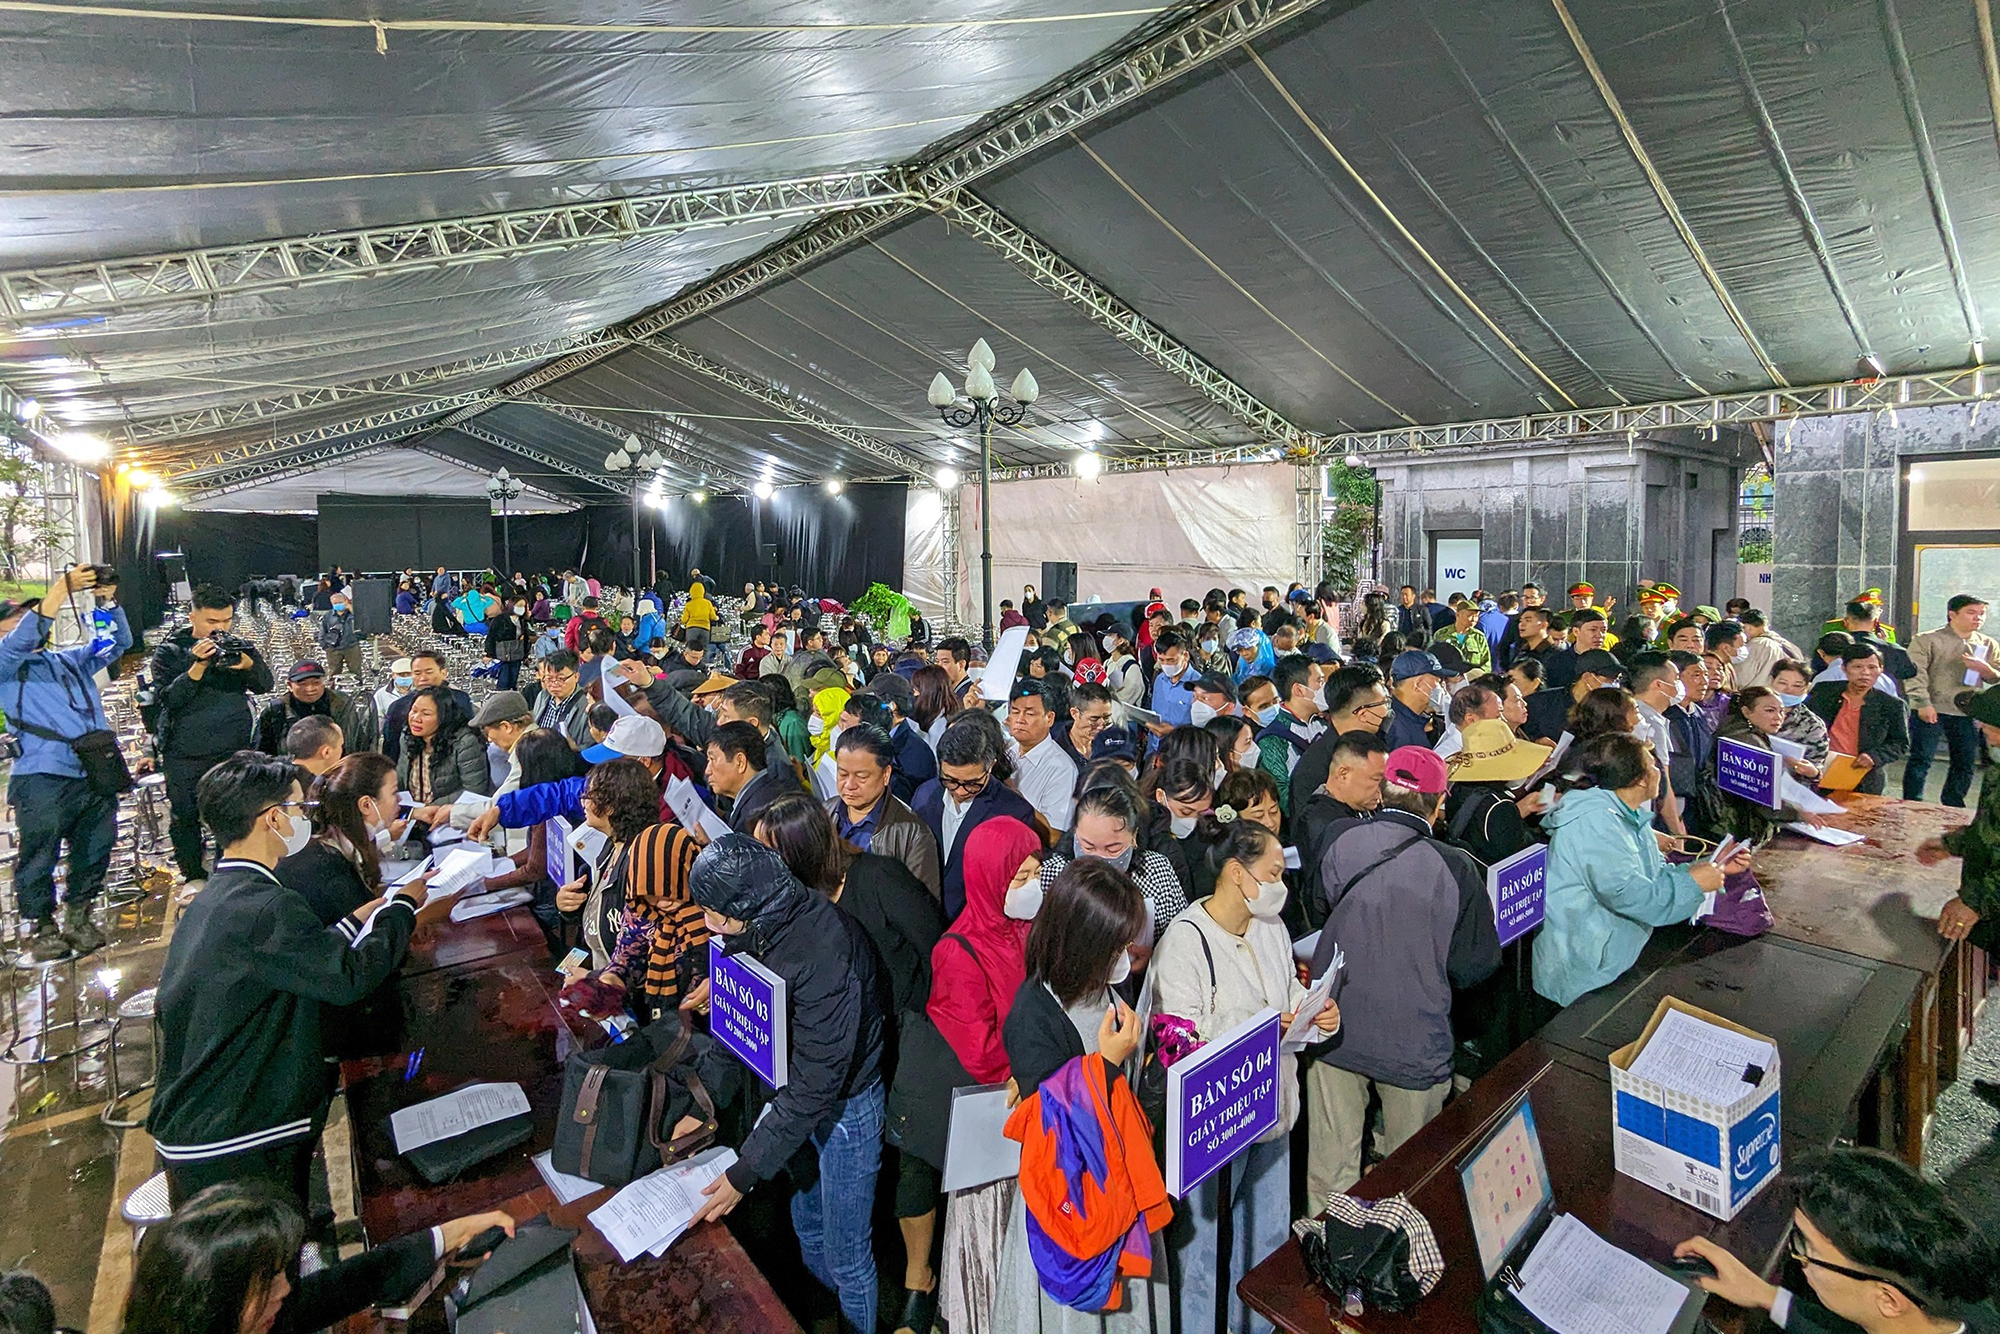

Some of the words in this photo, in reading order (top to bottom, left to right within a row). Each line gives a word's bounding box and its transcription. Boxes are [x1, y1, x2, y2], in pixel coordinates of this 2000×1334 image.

[1444, 568, 1466, 579] WC
[1722, 751, 1741, 766] BÀN
[1743, 758, 1756, 771] SỐ
[1758, 764, 1769, 775] 07
[1501, 879, 1519, 901] BÀN
[1521, 869, 1532, 890] SỐ
[1534, 867, 1542, 882] 05
[715, 966, 736, 997] BÀN
[739, 986, 755, 1011] SỐ
[756, 999, 768, 1022] 03
[714, 994, 731, 1015] GIẤY
[732, 1006, 754, 1033] TRIỆU
[754, 1026, 769, 1045] TẬP
[733, 1026, 758, 1053] 2001-3000
[1190, 1075, 1228, 1119] BÀN
[1231, 1055, 1253, 1091] SỐ
[1256, 1046, 1272, 1073] 04
[1188, 1118, 1217, 1147] GIẤY
[1219, 1093, 1251, 1125] TRIỆU
[1252, 1078, 1272, 1101] TẬP
[1206, 1135, 1220, 1154] SỐ
[1220, 1109, 1256, 1145] 3001-4000
[1737, 1123, 1773, 1169] Supreme
